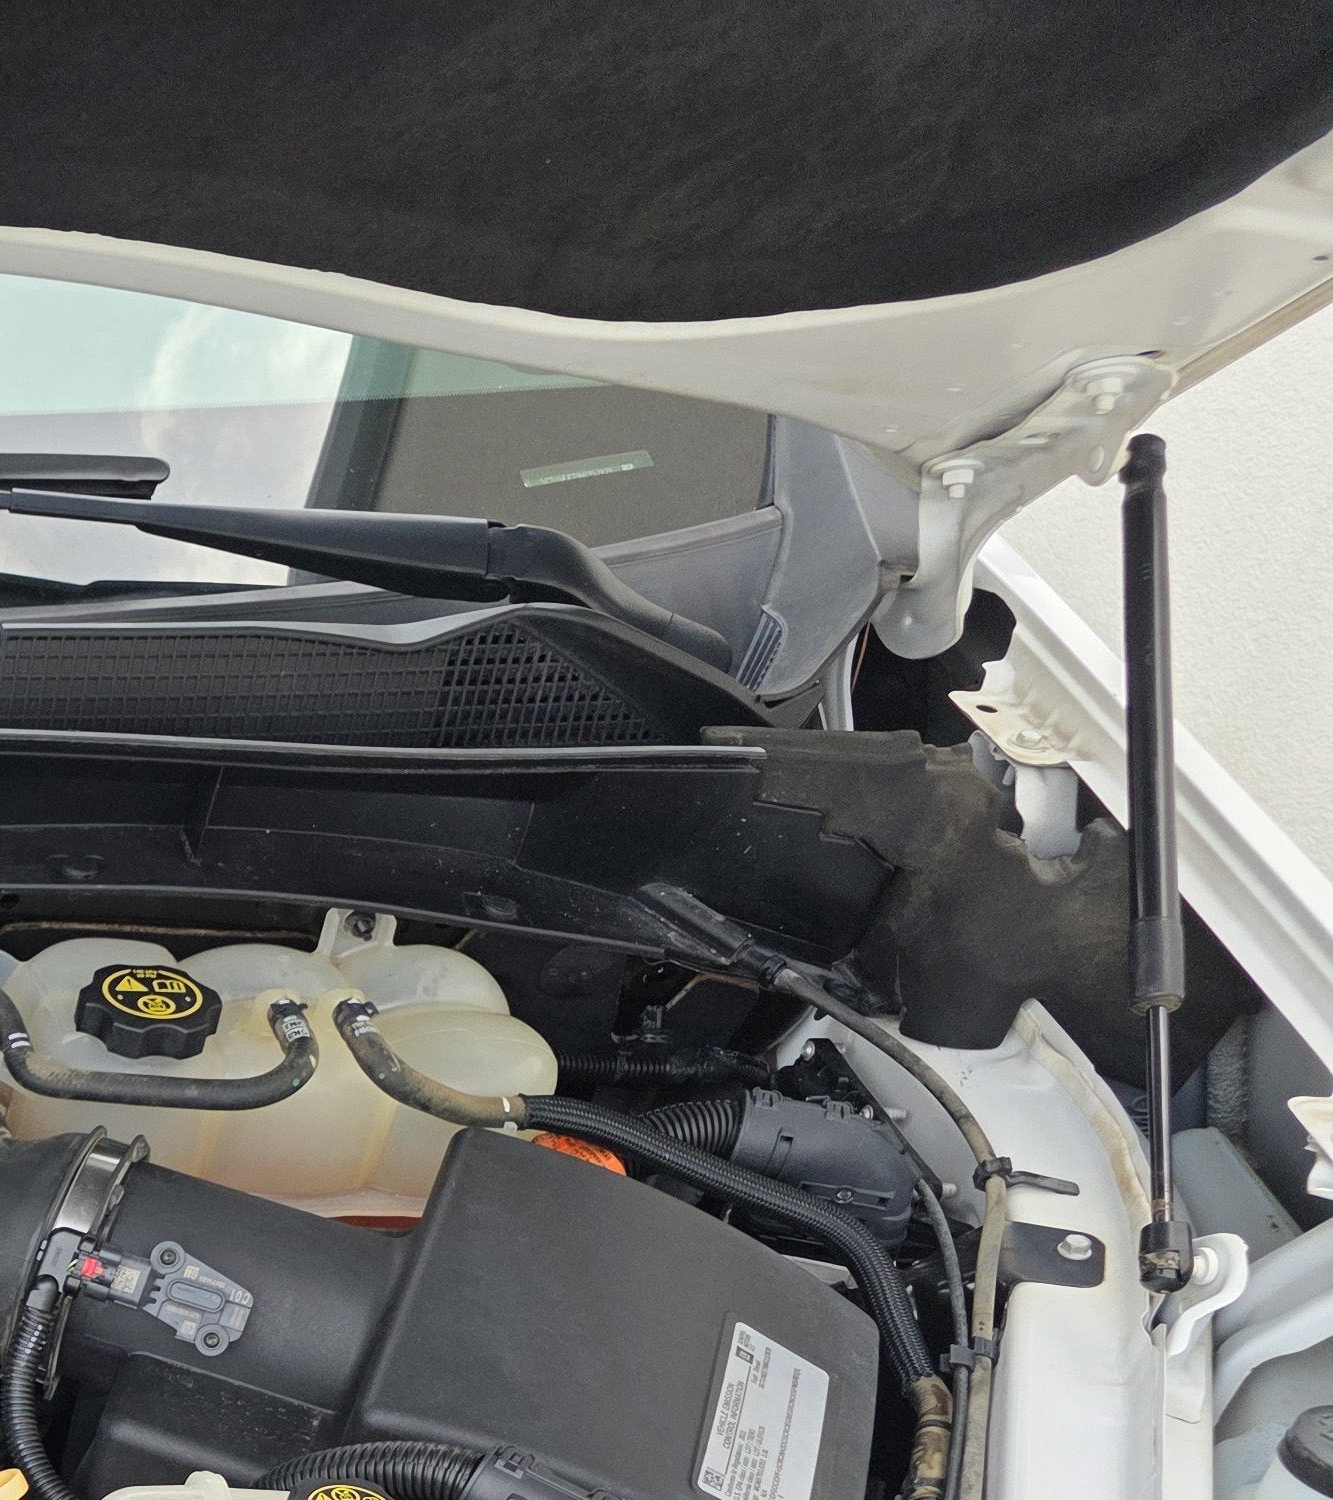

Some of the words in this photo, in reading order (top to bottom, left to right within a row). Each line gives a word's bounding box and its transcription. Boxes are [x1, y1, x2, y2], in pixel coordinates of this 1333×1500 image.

[721, 1382, 734, 1411] EMISSION
[716, 1409, 728, 1435] VEHICLE
[722, 1420, 735, 1449] CONTROL
[730, 1380, 744, 1420] INFORMATION
